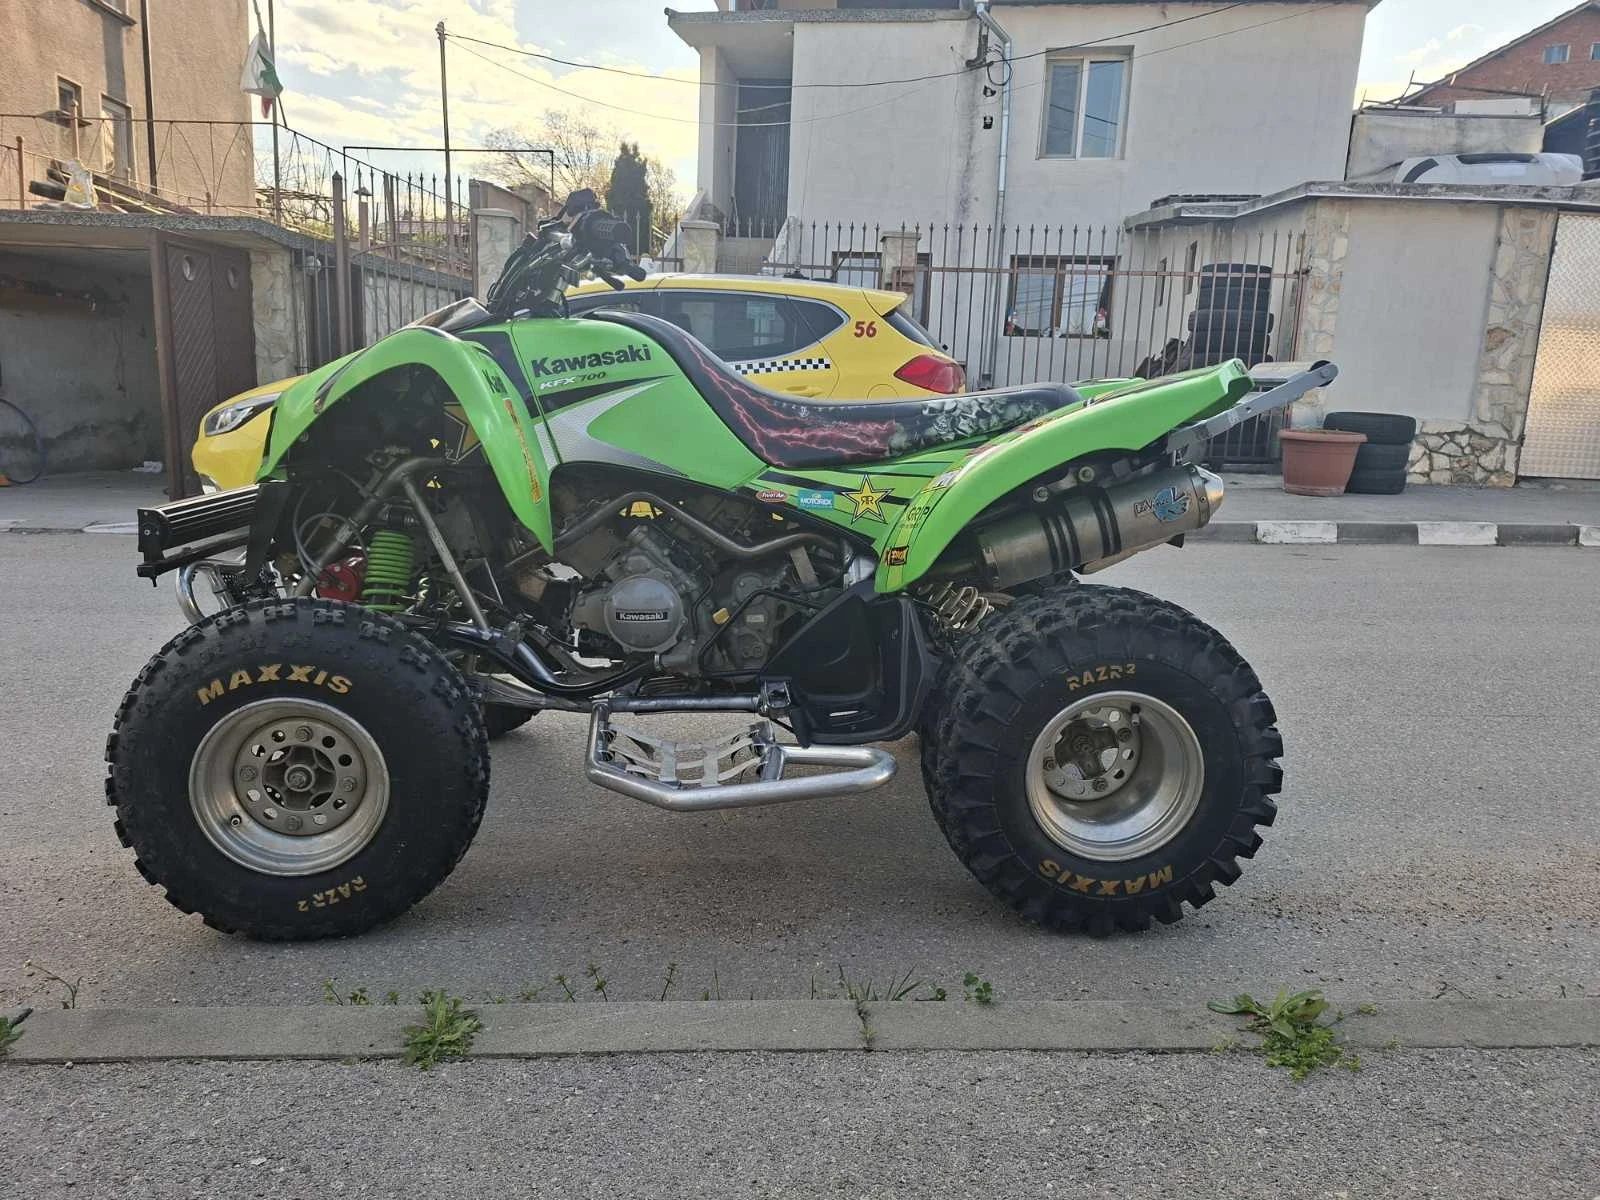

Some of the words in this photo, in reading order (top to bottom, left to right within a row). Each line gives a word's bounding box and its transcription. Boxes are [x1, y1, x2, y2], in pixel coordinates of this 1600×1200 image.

[853, 320, 877, 339] 56
[531, 343, 652, 378] Kawasaki
[540, 376, 577, 390] KFX
[577, 371, 607, 382] 700
[619, 612, 664, 621] Kawasaki
[197, 663, 353, 706] MAXXIS
[1038, 859, 1174, 897] MAXXIS
